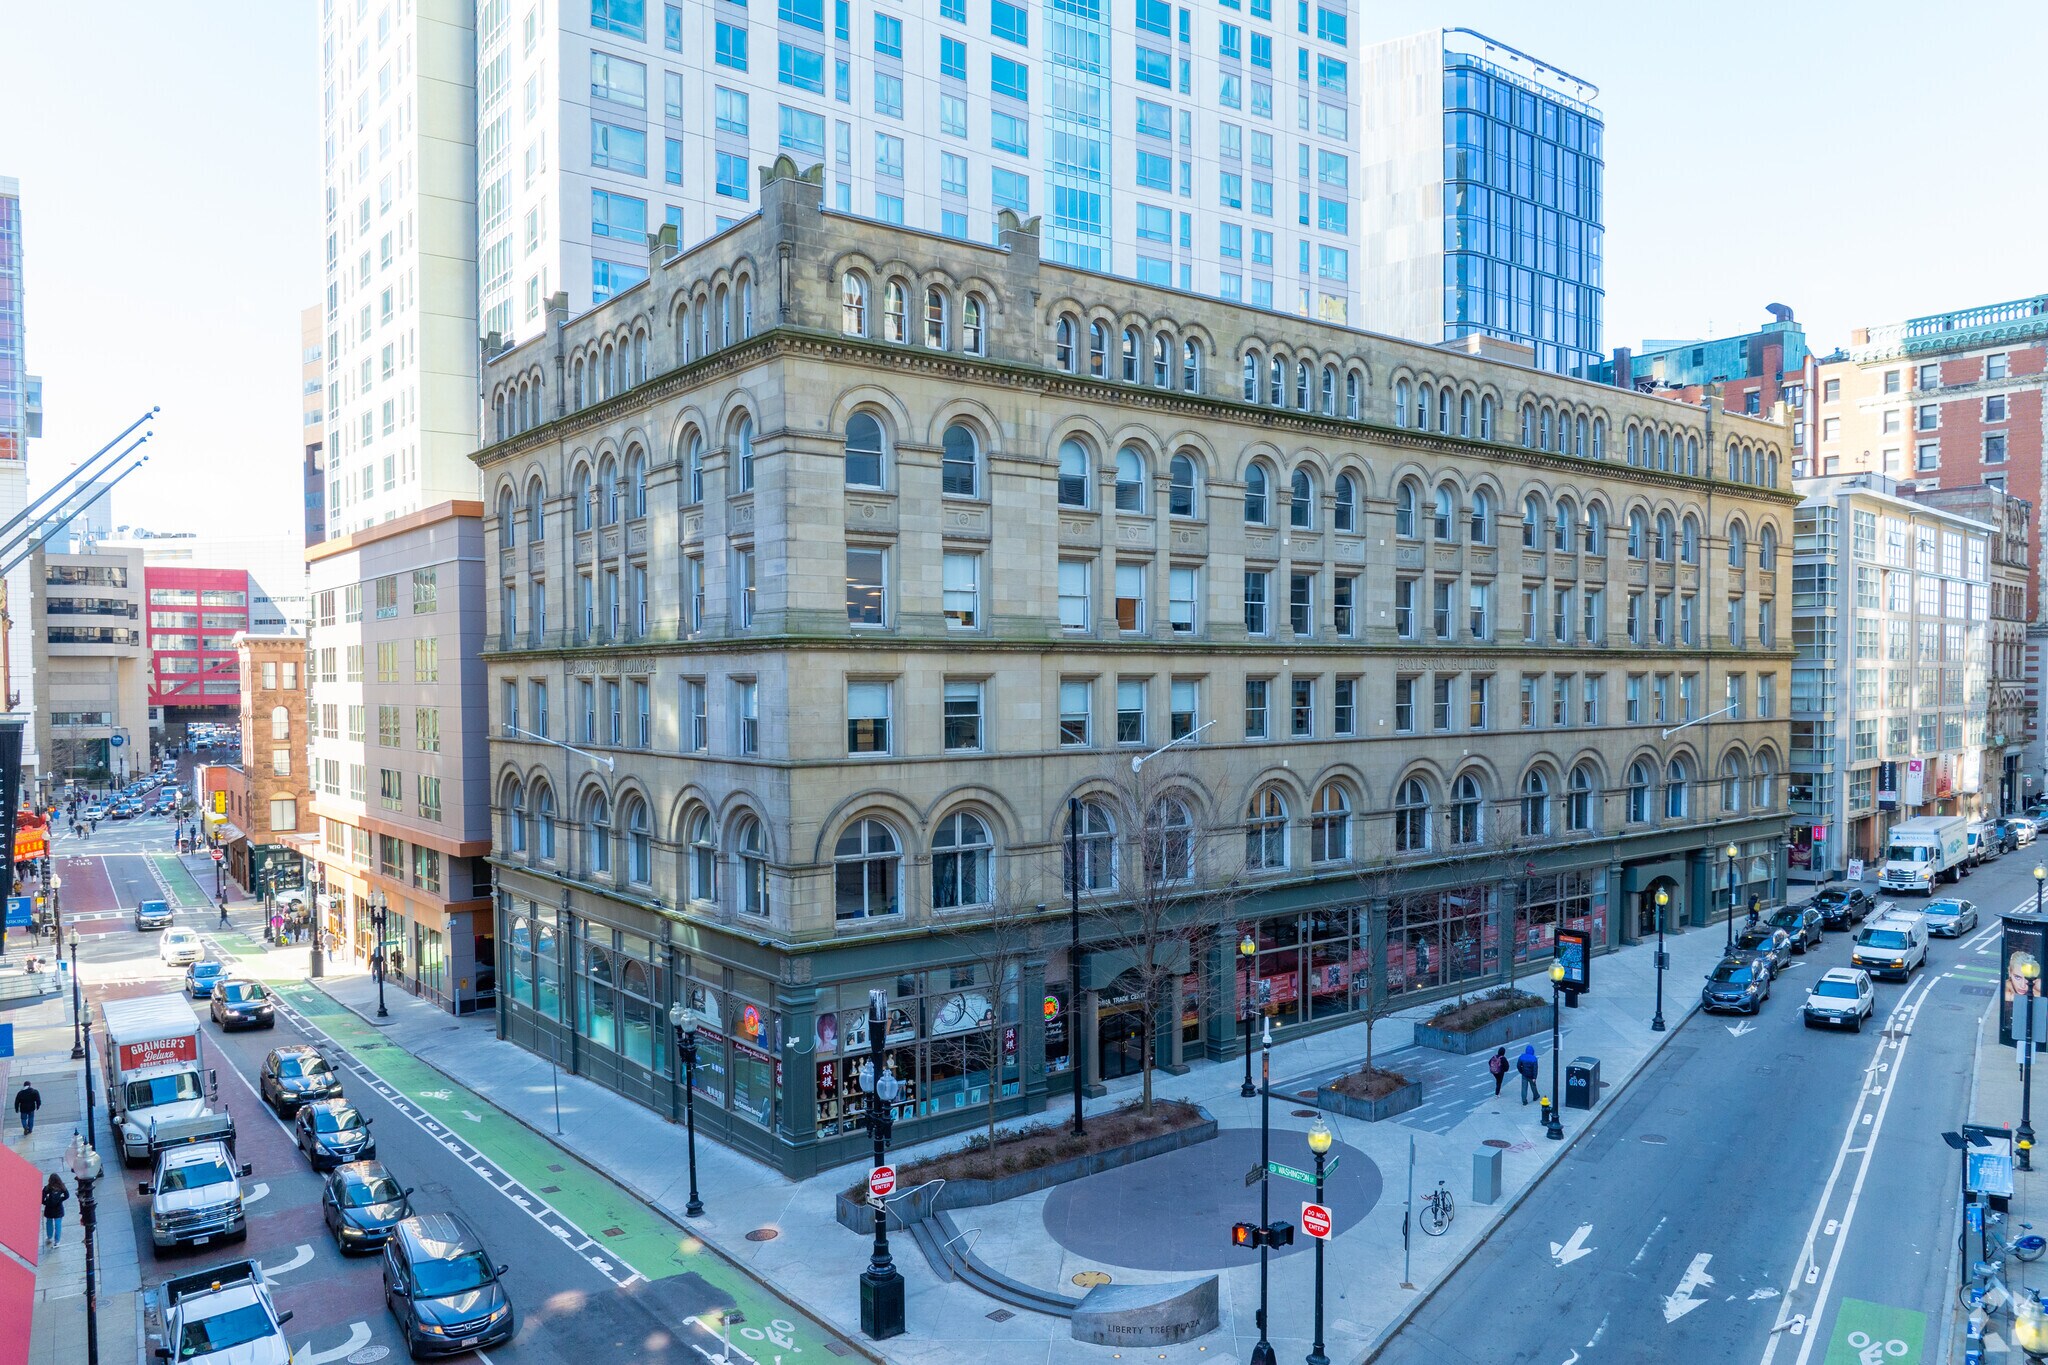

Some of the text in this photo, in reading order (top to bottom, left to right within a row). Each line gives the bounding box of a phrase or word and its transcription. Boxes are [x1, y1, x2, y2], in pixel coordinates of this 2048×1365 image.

[574, 658, 648, 674] BOYLSTON BUILDING
[1397, 658, 1497, 671] BOYLSTON BUILDING
[8, 902, 20, 914] P
[5, 917, 28, 925] ARKING
[1113, 995, 1129, 1003] TRADE
[130, 1038, 186, 1055] GRAINGER'S
[144, 1050, 175, 1062] Deluxe
[1277, 1166, 1310, 1182] WASHINGTON
[1315, 1211, 1326, 1219] NOT
[1308, 1224, 1325, 1232] ENTER
[1107, 1319, 1201, 1335] LIBERTY TREE PLAZA
